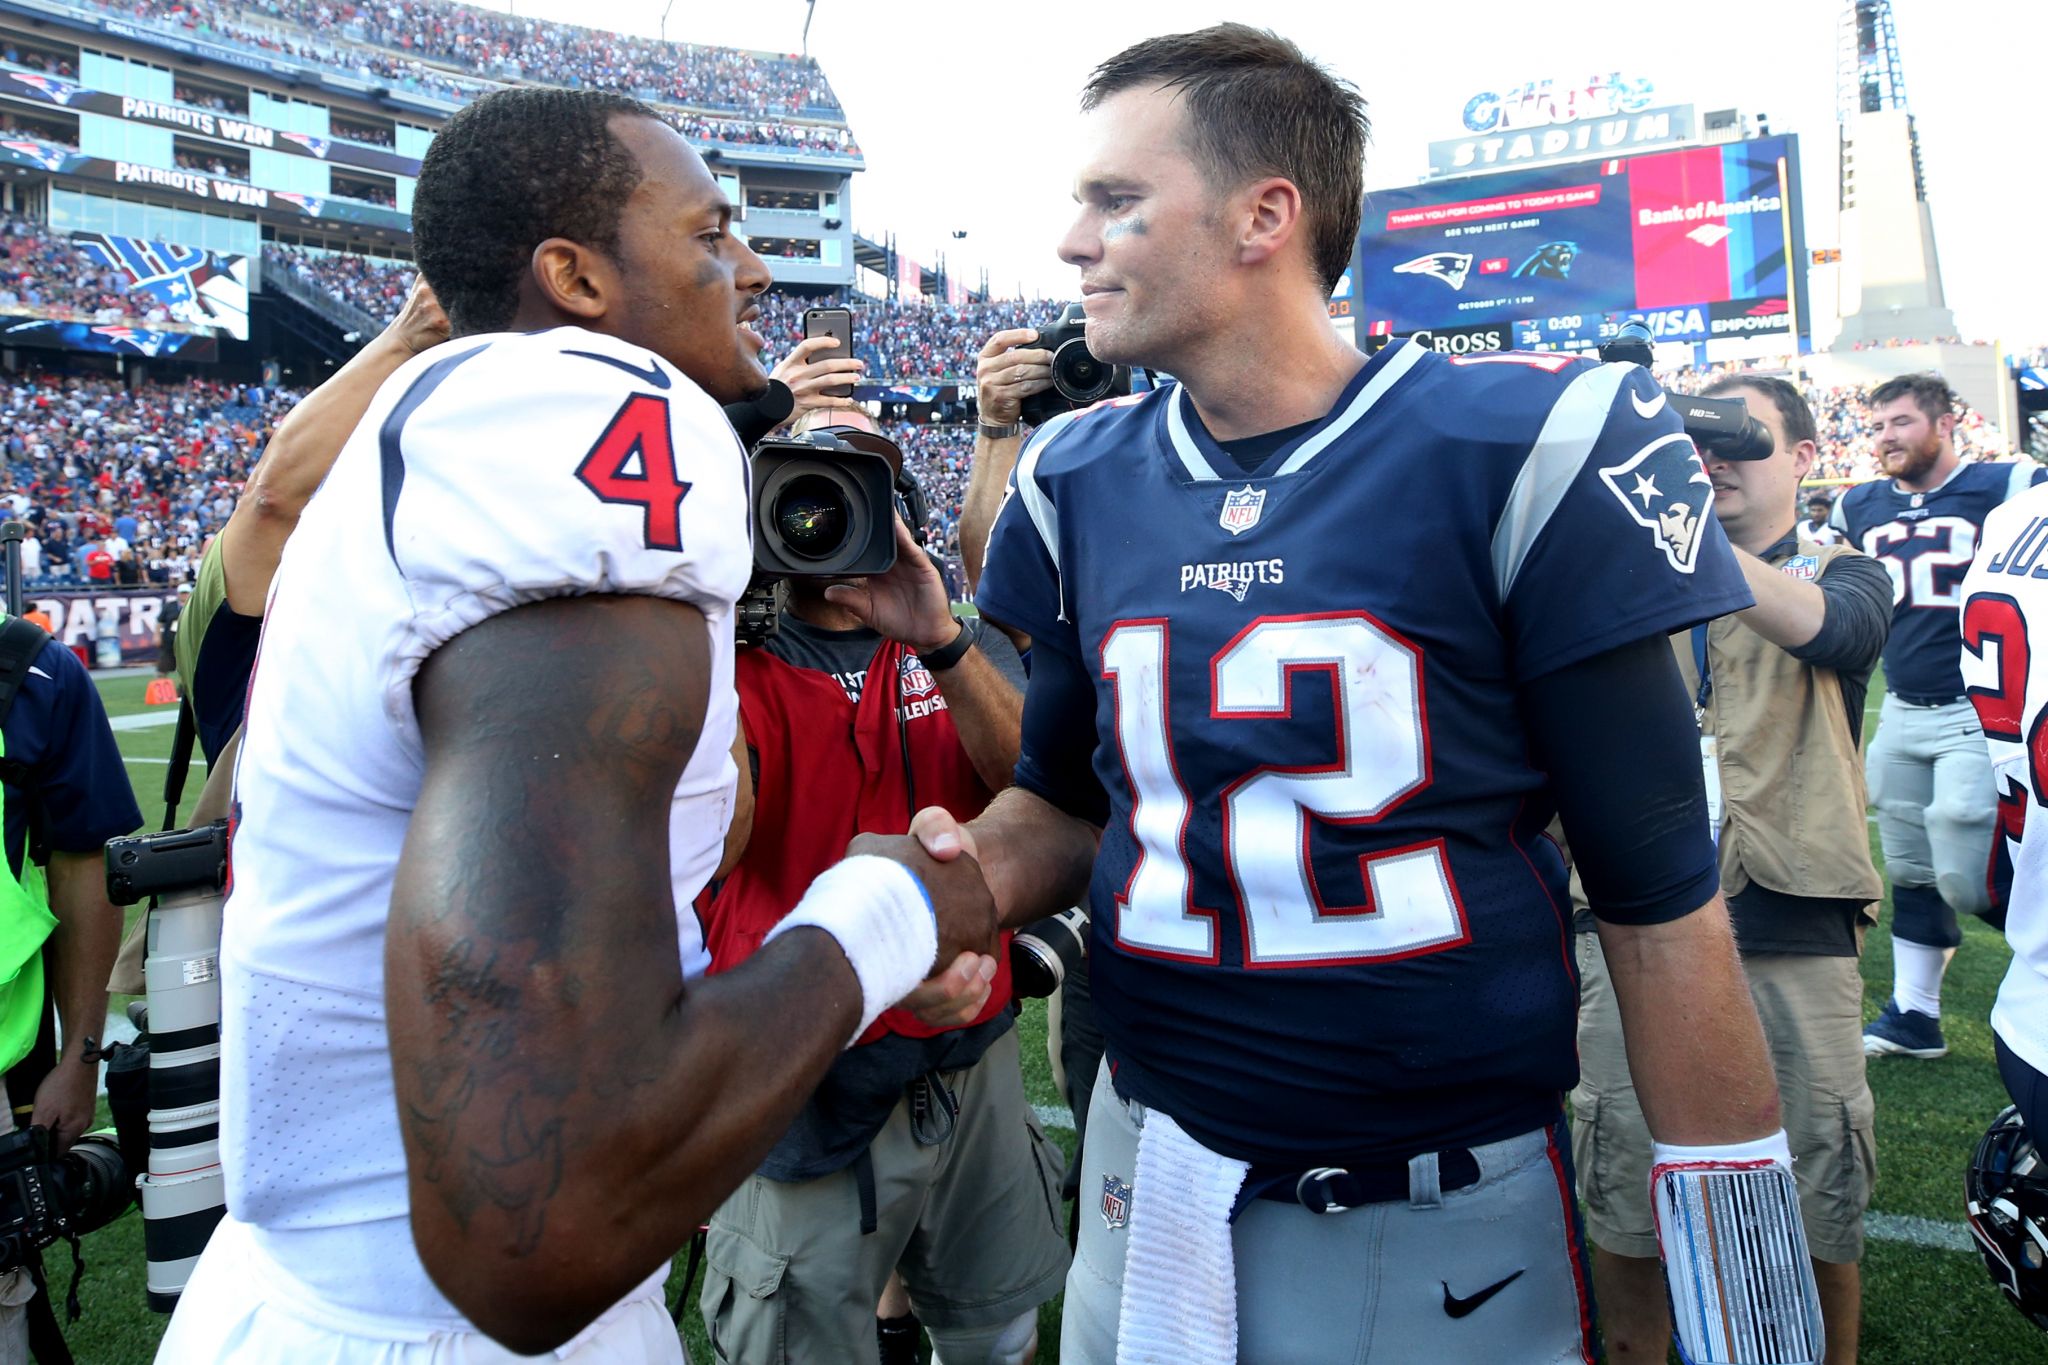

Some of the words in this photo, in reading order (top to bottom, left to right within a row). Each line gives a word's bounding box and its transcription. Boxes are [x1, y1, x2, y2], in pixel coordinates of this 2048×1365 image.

[122, 97, 215, 135] PATRIOTS
[218, 118, 274, 147] WIN
[1453, 113, 1670, 167] STADIUM
[115, 161, 209, 197] PATRIOTS
[213, 181, 268, 208] WIN
[1391, 214, 1424, 225] THANK
[1425, 210, 1446, 221] YOU
[1447, 207, 1467, 218] FOR
[1468, 203, 1505, 215] COMING
[1507, 199, 1521, 210] TO
[1522, 194, 1564, 207] TODAY'S
[1565, 190, 1595, 203] GAME
[1639, 205, 1684, 225] Bank
[1685, 201, 1704, 220] of
[1705, 195, 1781, 217] America
[1444, 228, 1462, 238] SEE
[1463, 225, 1483, 235] YOU
[1484, 222, 1508, 233] NEXT
[1510, 218, 1540, 229] GAME!
[1486, 261, 1502, 270] VS
[1547, 315, 1583, 330] 0:00
[1599, 323, 1619, 337] 33
[1410, 330, 1502, 354] CROSS
[1521, 330, 1542, 344] 36
[573, 391, 693, 553] 4
[1226, 507, 1254, 525] NFL
[1862, 515, 1978, 607] 62
[1180, 558, 1284, 593] PATRIOTS
[902, 671, 934, 691] NFL
[1099, 609, 1473, 970] 12
[1104, 1194, 1124, 1220] NFL
